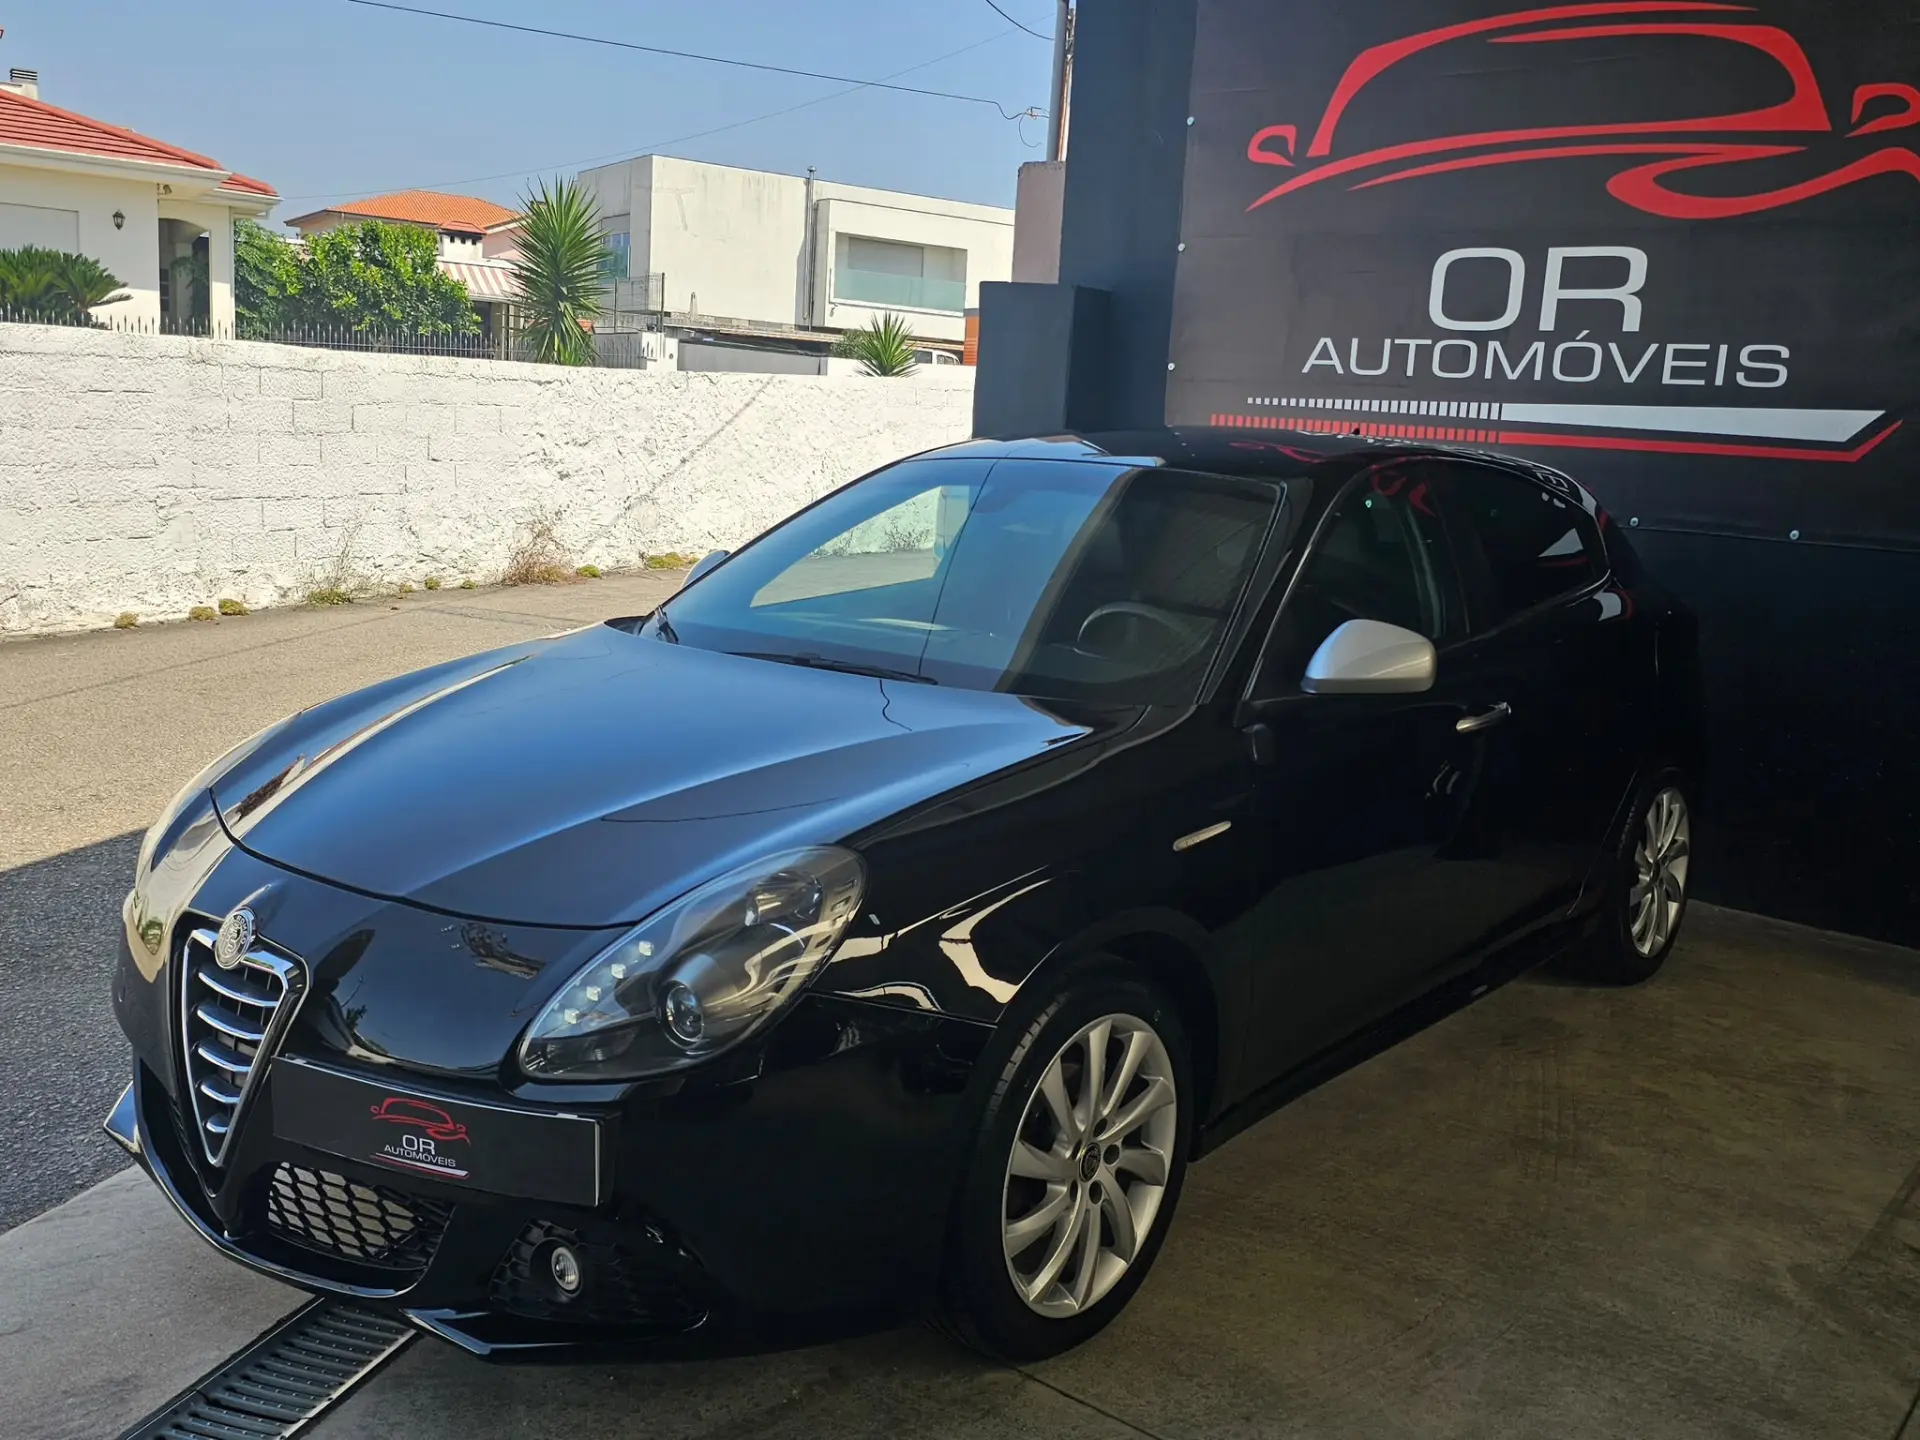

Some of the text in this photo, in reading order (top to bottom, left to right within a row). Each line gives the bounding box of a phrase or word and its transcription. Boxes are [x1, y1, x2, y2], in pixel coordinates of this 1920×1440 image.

[1428, 245, 1648, 332] OR
[1301, 330, 1790, 388] AUTOMÓVEIS
[384, 1144, 456, 1167] AUTOMÓVEIS
[402, 1134, 435, 1155] OR
